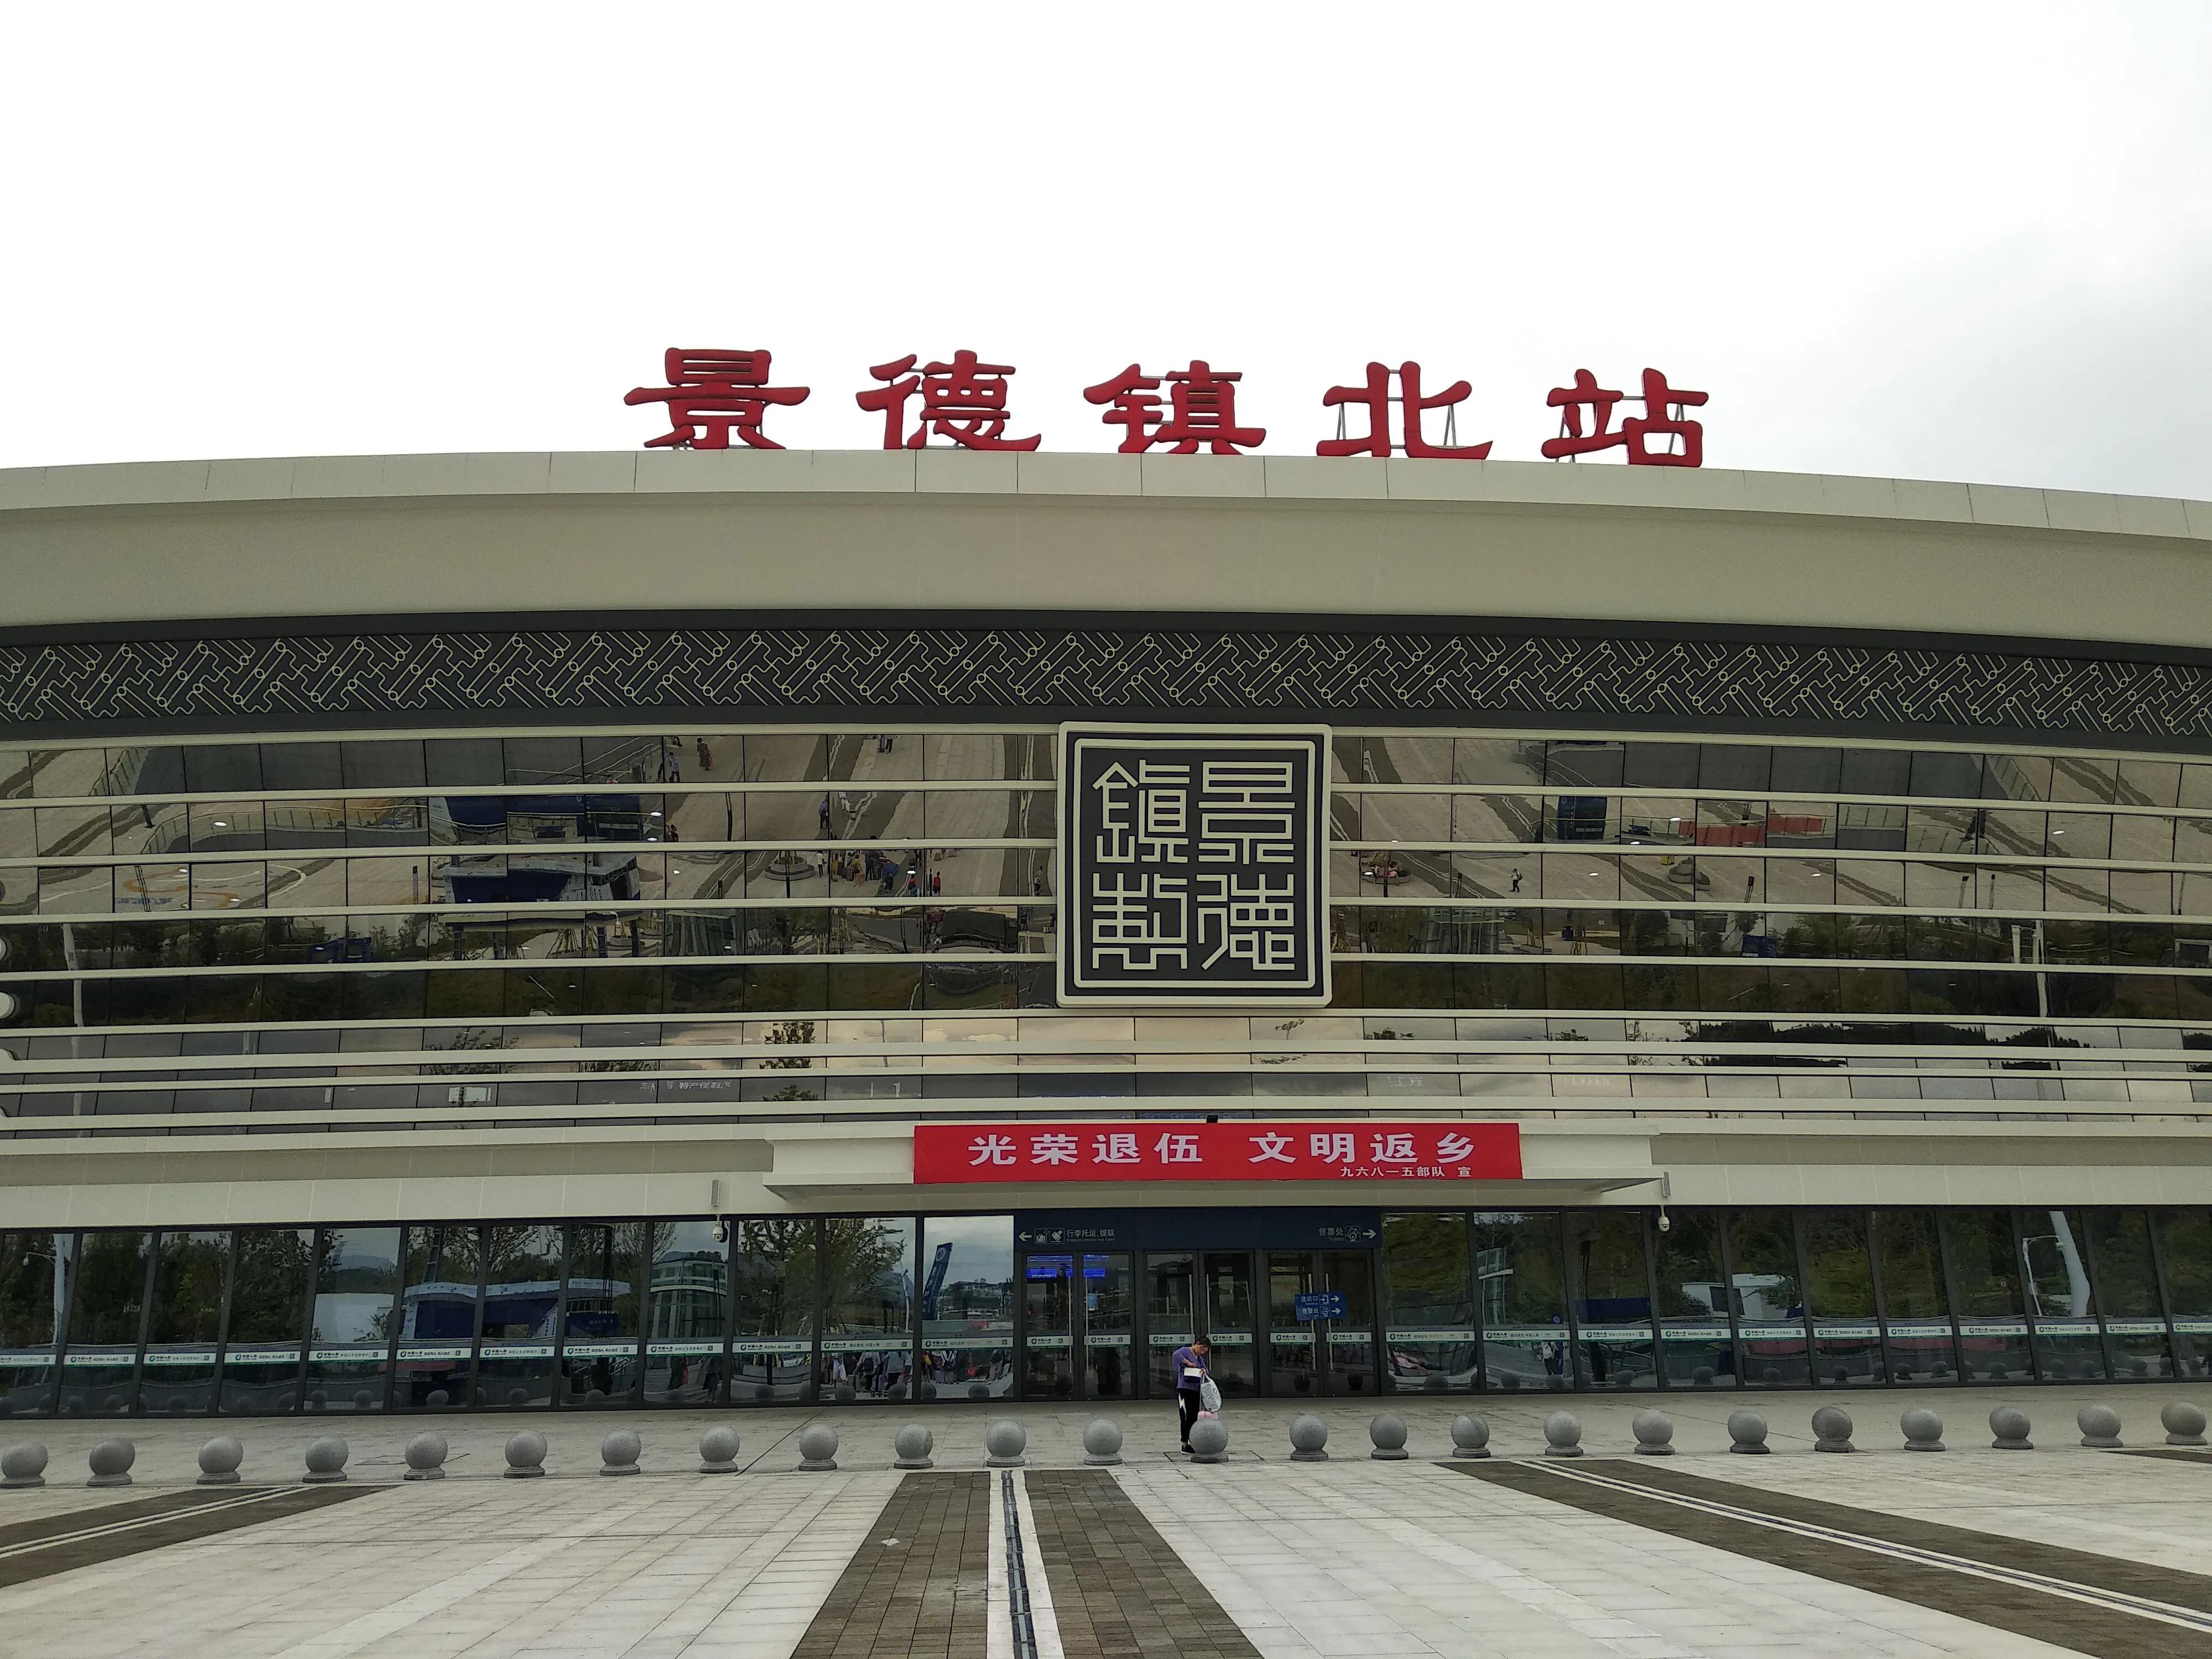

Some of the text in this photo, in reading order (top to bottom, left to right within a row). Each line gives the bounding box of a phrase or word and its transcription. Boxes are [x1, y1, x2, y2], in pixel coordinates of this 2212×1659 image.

[625, 348, 1708, 467] 景德镇北站
[968, 1131, 1474, 1166] 光荣退伍 文明返乡
[1340, 1166, 1471, 1177] 九六八一五部队 宣
[1318, 1227, 1344, 1236] 售票处
